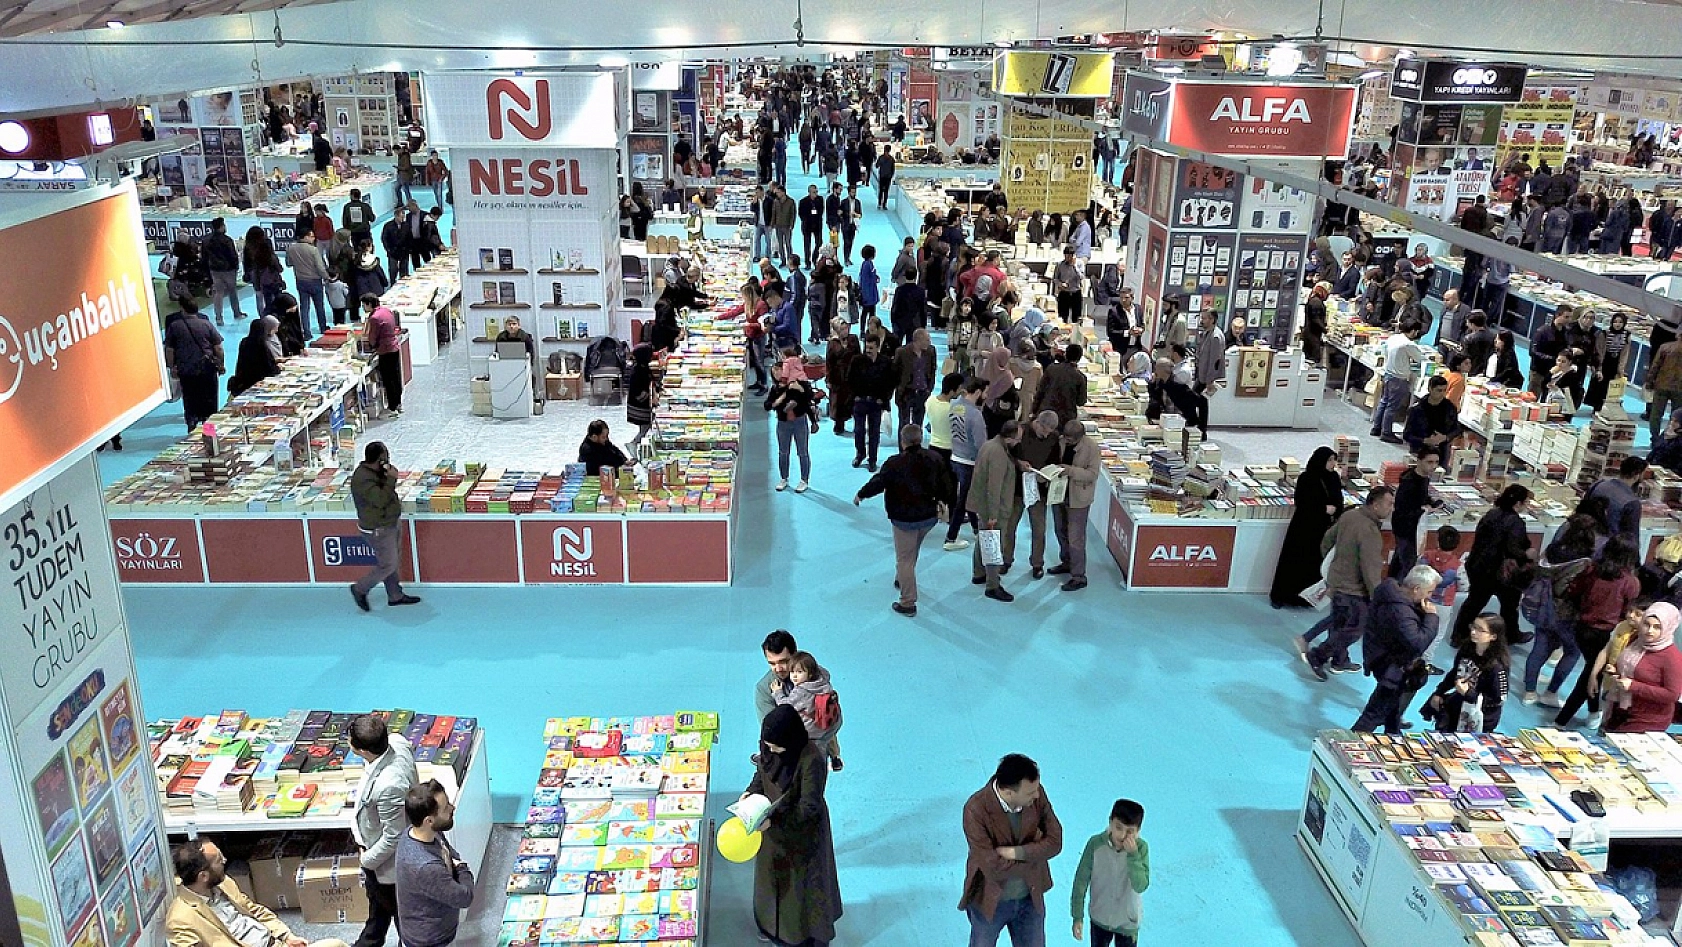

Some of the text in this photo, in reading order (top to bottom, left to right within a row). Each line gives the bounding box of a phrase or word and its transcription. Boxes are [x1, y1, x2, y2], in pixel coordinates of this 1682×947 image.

[949, 47, 995, 56] BEYA
[1209, 97, 1312, 123] ALFA
[1229, 126, 1290, 134] YAYIN GRUBU
[144, 222, 167, 238] rola
[24, 273, 141, 371] uçanbalık
[116, 532, 181, 559] SÖZ
[346, 544, 377, 556] ETKİLE
[1148, 544, 1218, 561] ALFA
[13, 532, 86, 611] TUDEM
[120, 559, 183, 570] YAYINLARI
[22, 570, 92, 650] YAYIN
[32, 608, 98, 688] GRUBU
[319, 886, 352, 897] TUDEM
[321, 895, 353, 904] YAYIN
